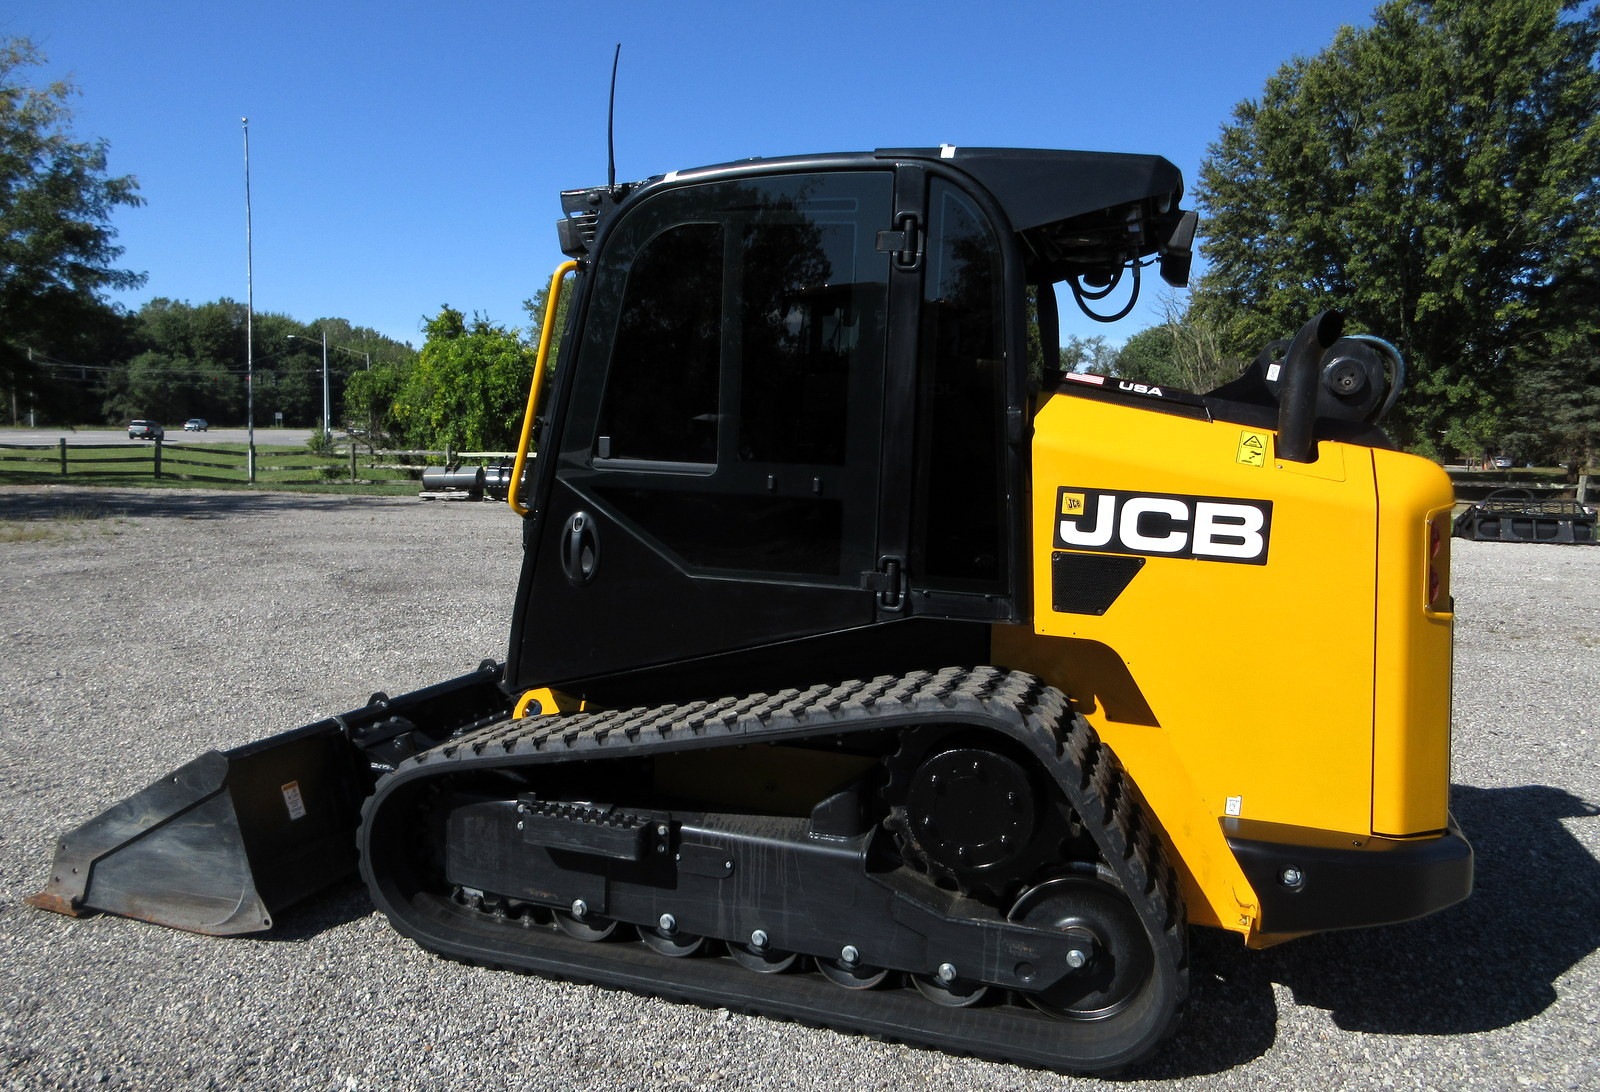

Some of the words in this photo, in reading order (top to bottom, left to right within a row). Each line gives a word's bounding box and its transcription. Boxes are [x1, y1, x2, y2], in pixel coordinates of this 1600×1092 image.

[1119, 381, 1162, 396] USA
[1067, 498, 1081, 510] JCB
[1060, 495, 1264, 558] JCB
